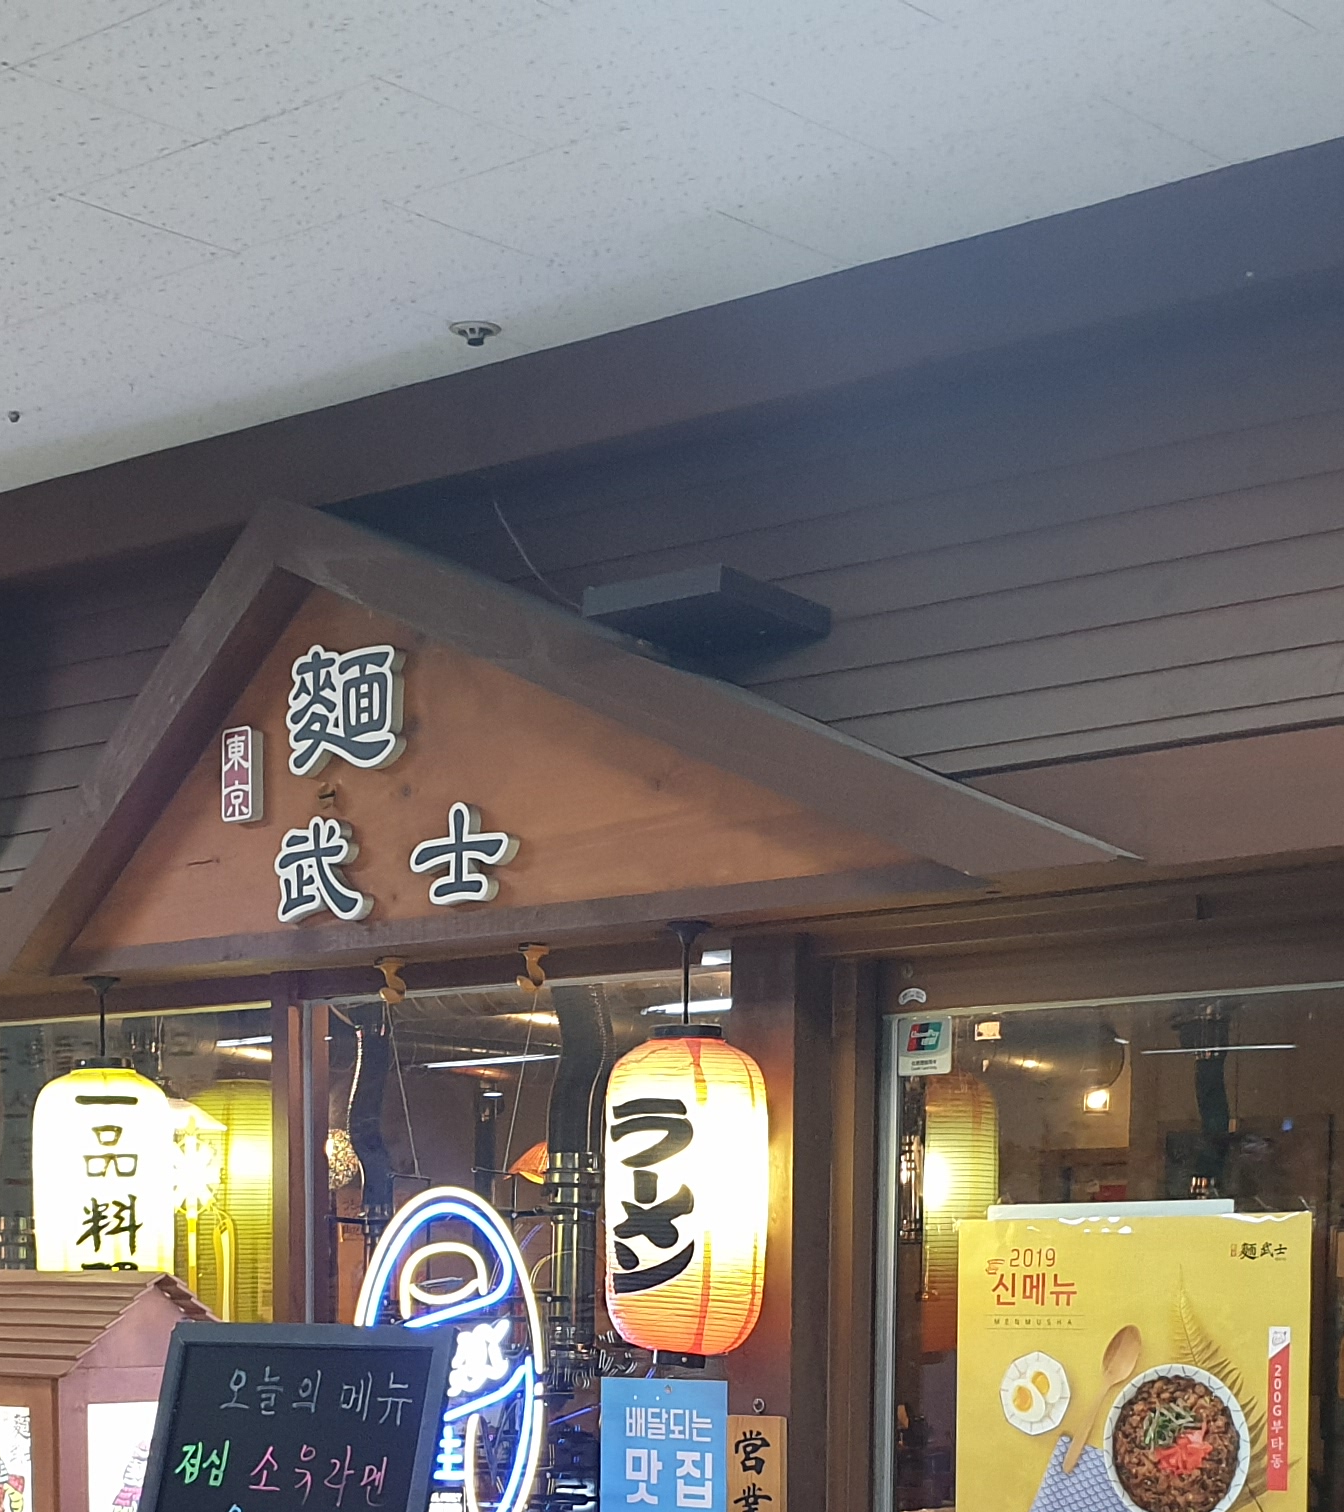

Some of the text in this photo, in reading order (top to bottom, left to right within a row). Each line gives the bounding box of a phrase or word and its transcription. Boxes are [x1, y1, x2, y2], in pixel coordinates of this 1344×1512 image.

[224, 733, 251, 819] 東京
[275, 802, 512, 923] 武士
[75, 1094, 143, 1270] 一品料
[611, 1096, 695, 1296] ラーメン
[1009, 1247, 1056, 1268] 2019
[991, 1272, 1078, 1307] 신메뉴
[219, 1366, 413, 1426] 오늘의 메뉴
[624, 1406, 713, 1442] 배달되는
[174, 1439, 231, 1487] 점심
